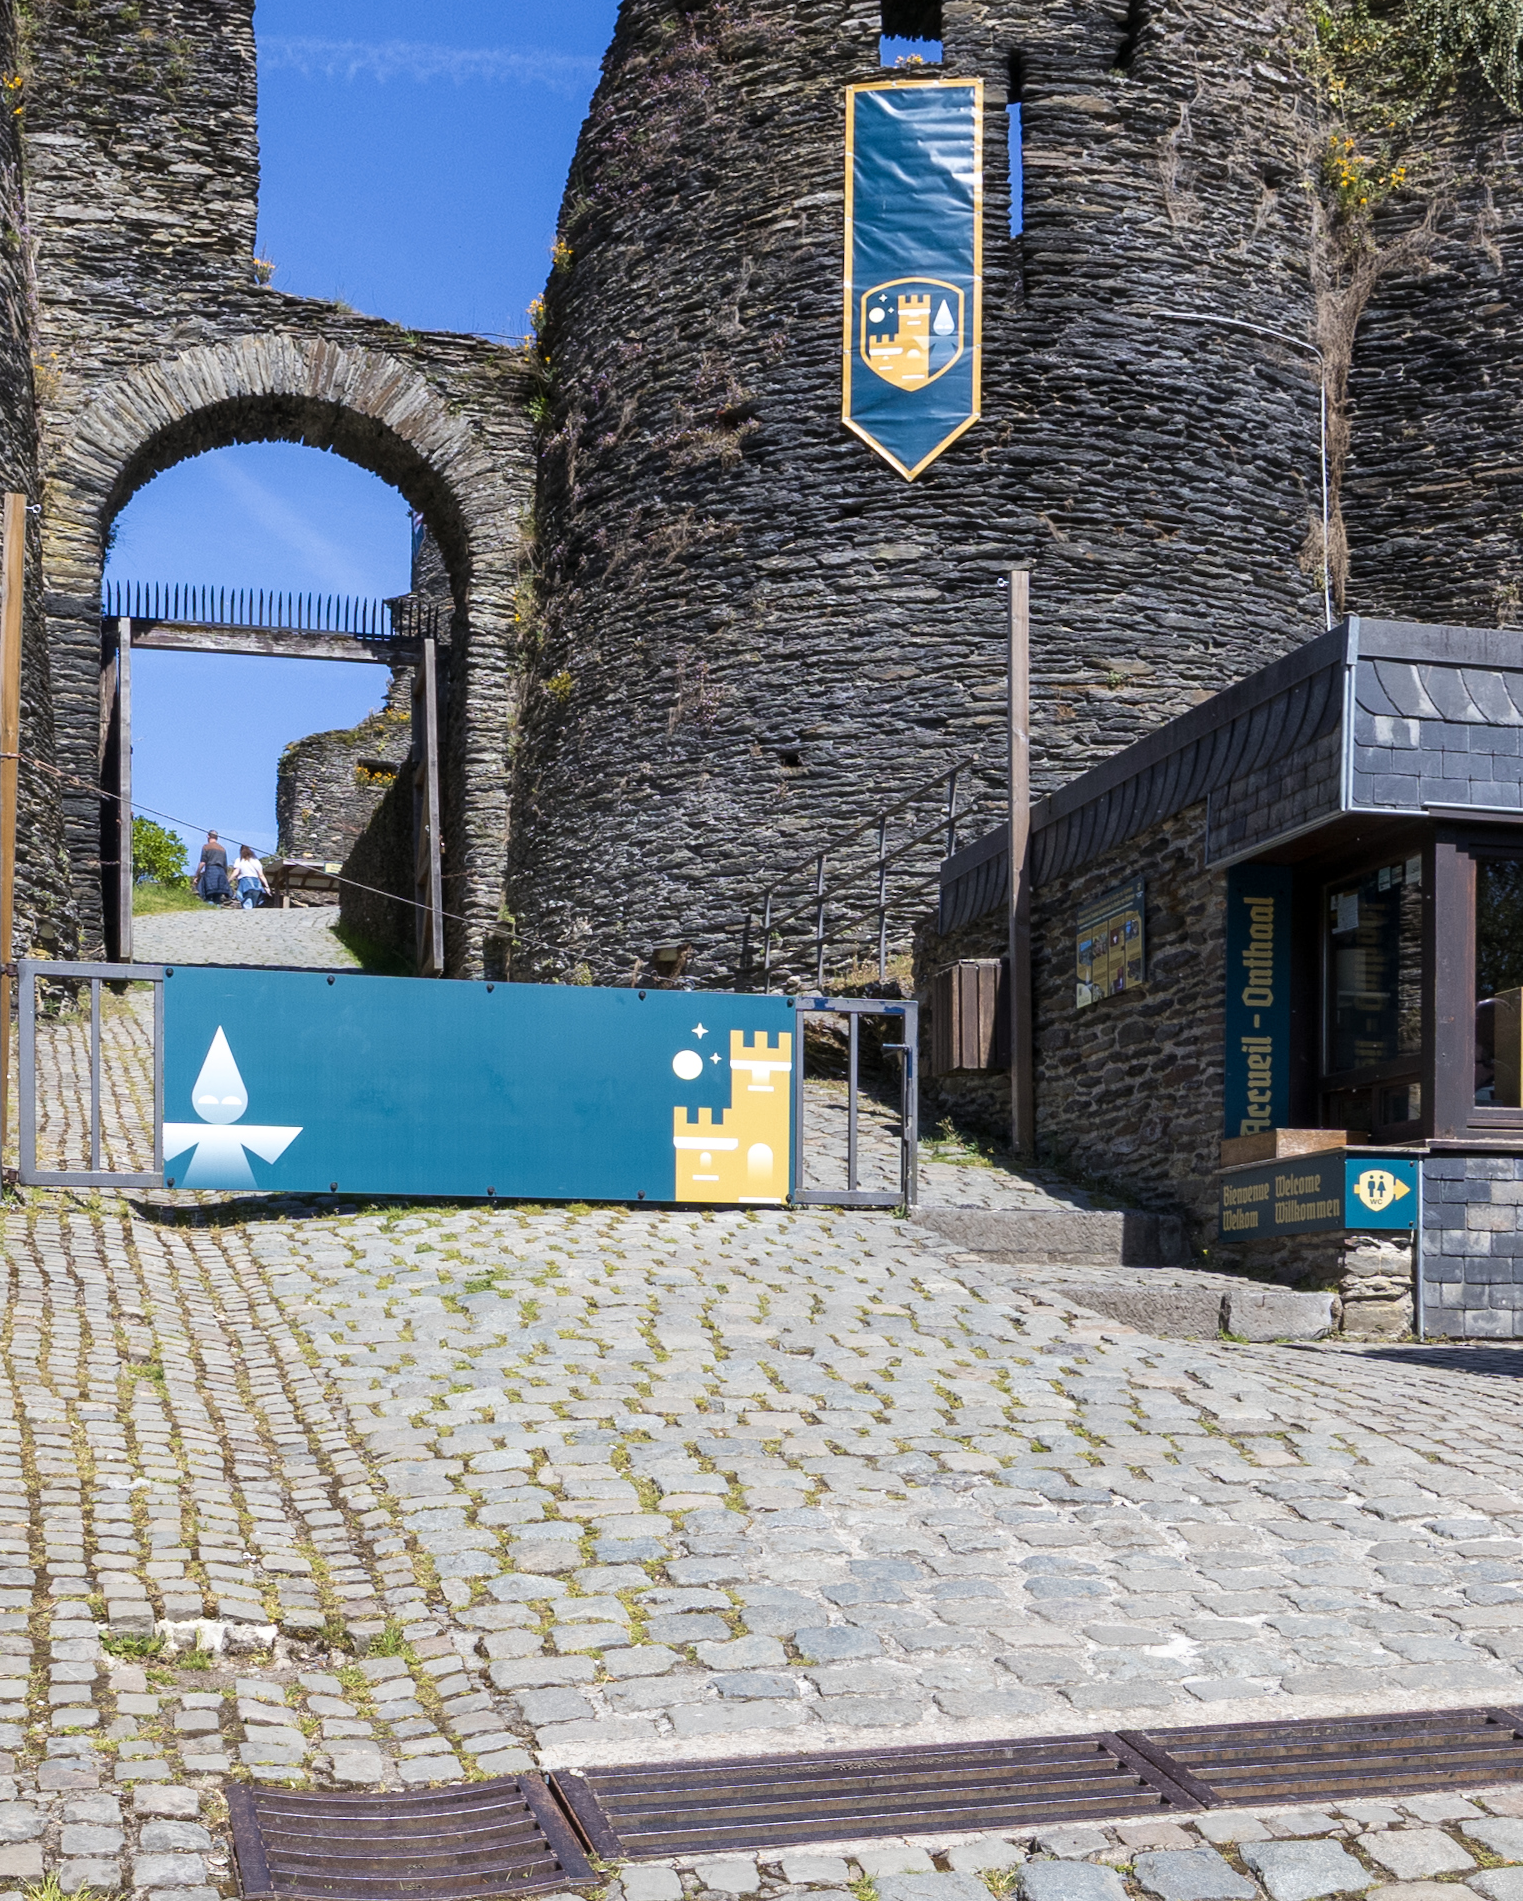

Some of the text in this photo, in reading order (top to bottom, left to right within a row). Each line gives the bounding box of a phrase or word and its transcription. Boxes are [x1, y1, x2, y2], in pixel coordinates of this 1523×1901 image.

[1241, 897, 1274, 1007] Onthaal
[1240, 1036, 1272, 1136] Accueil
[1223, 1182, 1270, 1207] Bienvenue
[1275, 1173, 1321, 1197] Welcome
[1223, 1208, 1258, 1231] Welkom
[1275, 1199, 1340, 1224] Willkommen
